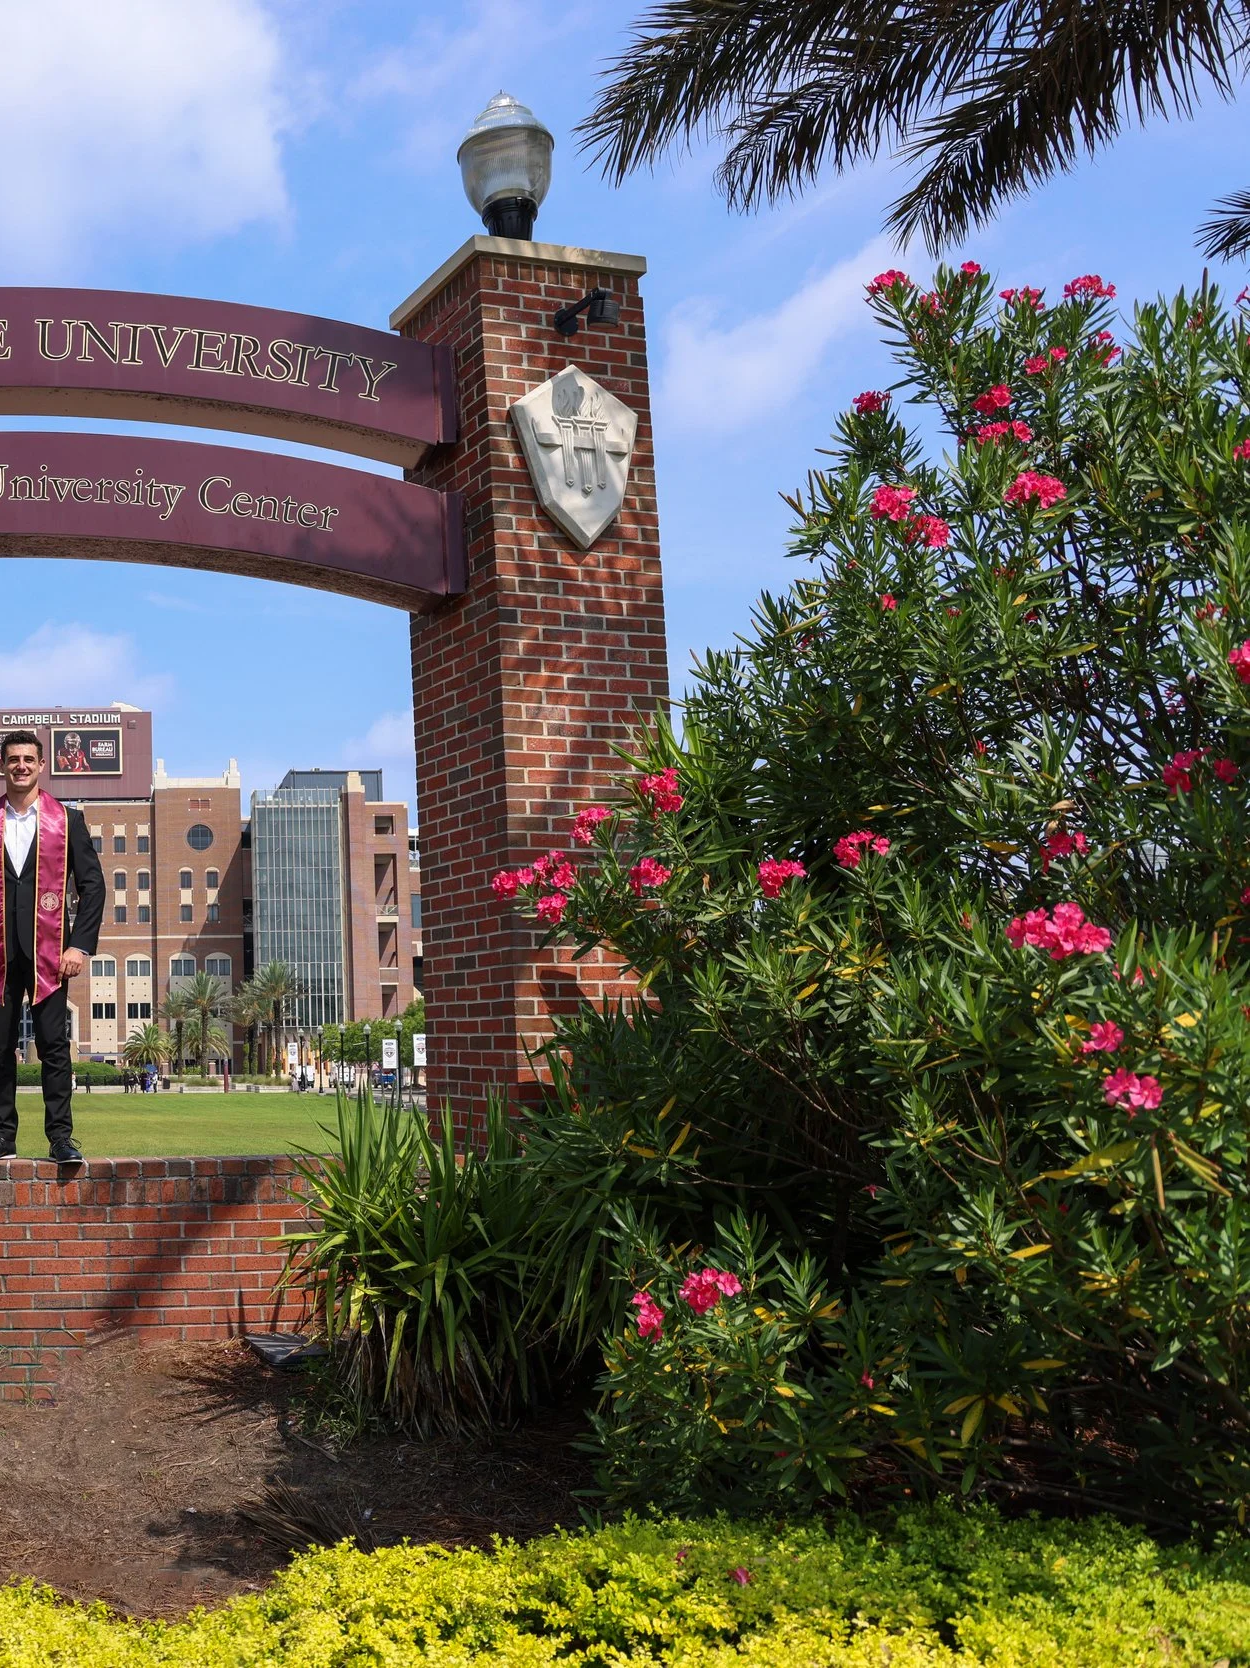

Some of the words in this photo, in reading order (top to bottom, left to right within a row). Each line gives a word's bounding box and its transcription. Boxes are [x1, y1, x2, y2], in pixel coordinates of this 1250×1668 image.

[34, 318, 398, 402] UNIVERSITY
[198, 476, 340, 532] Center
[2, 714, 64, 725] CAMPBELL
[69, 713, 121, 724] STADIUM
